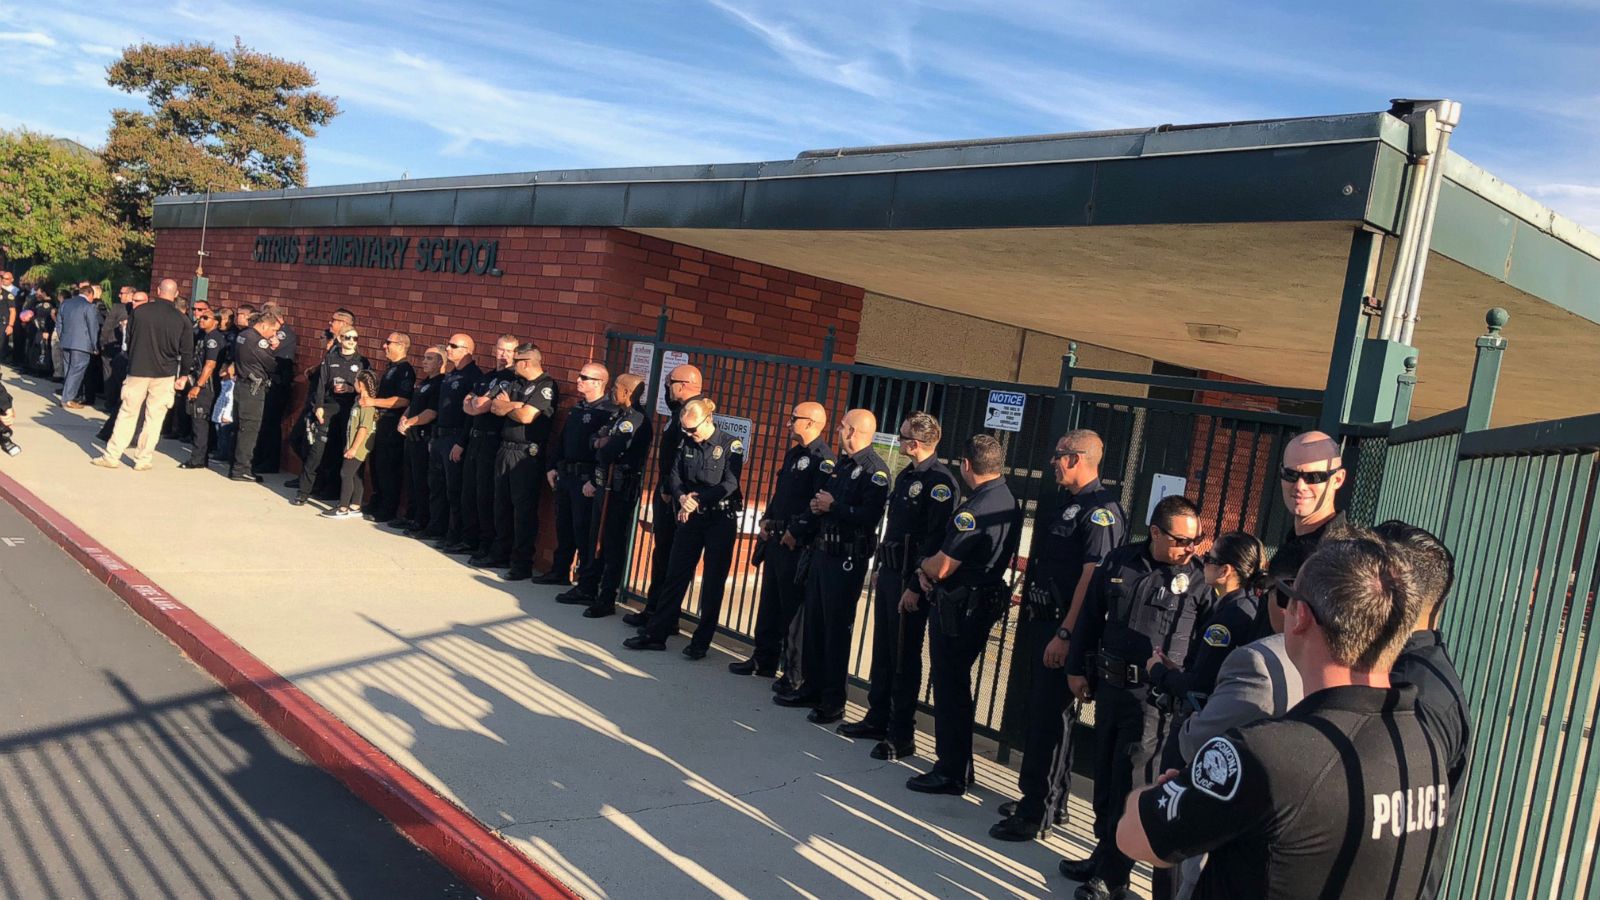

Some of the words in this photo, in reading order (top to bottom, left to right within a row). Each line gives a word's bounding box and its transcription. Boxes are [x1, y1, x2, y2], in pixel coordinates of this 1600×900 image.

[253, 235, 300, 264] CITRUS
[304, 235, 410, 270] ELEMENTARY
[415, 237, 504, 277] SCHOOL
[990, 392, 1023, 405] NOTICE
[717, 420, 748, 434] VISITORS
[1195, 761, 1215, 789] POLICE
[1211, 741, 1238, 778] POMONA
[1371, 783, 1446, 840] POLICE
